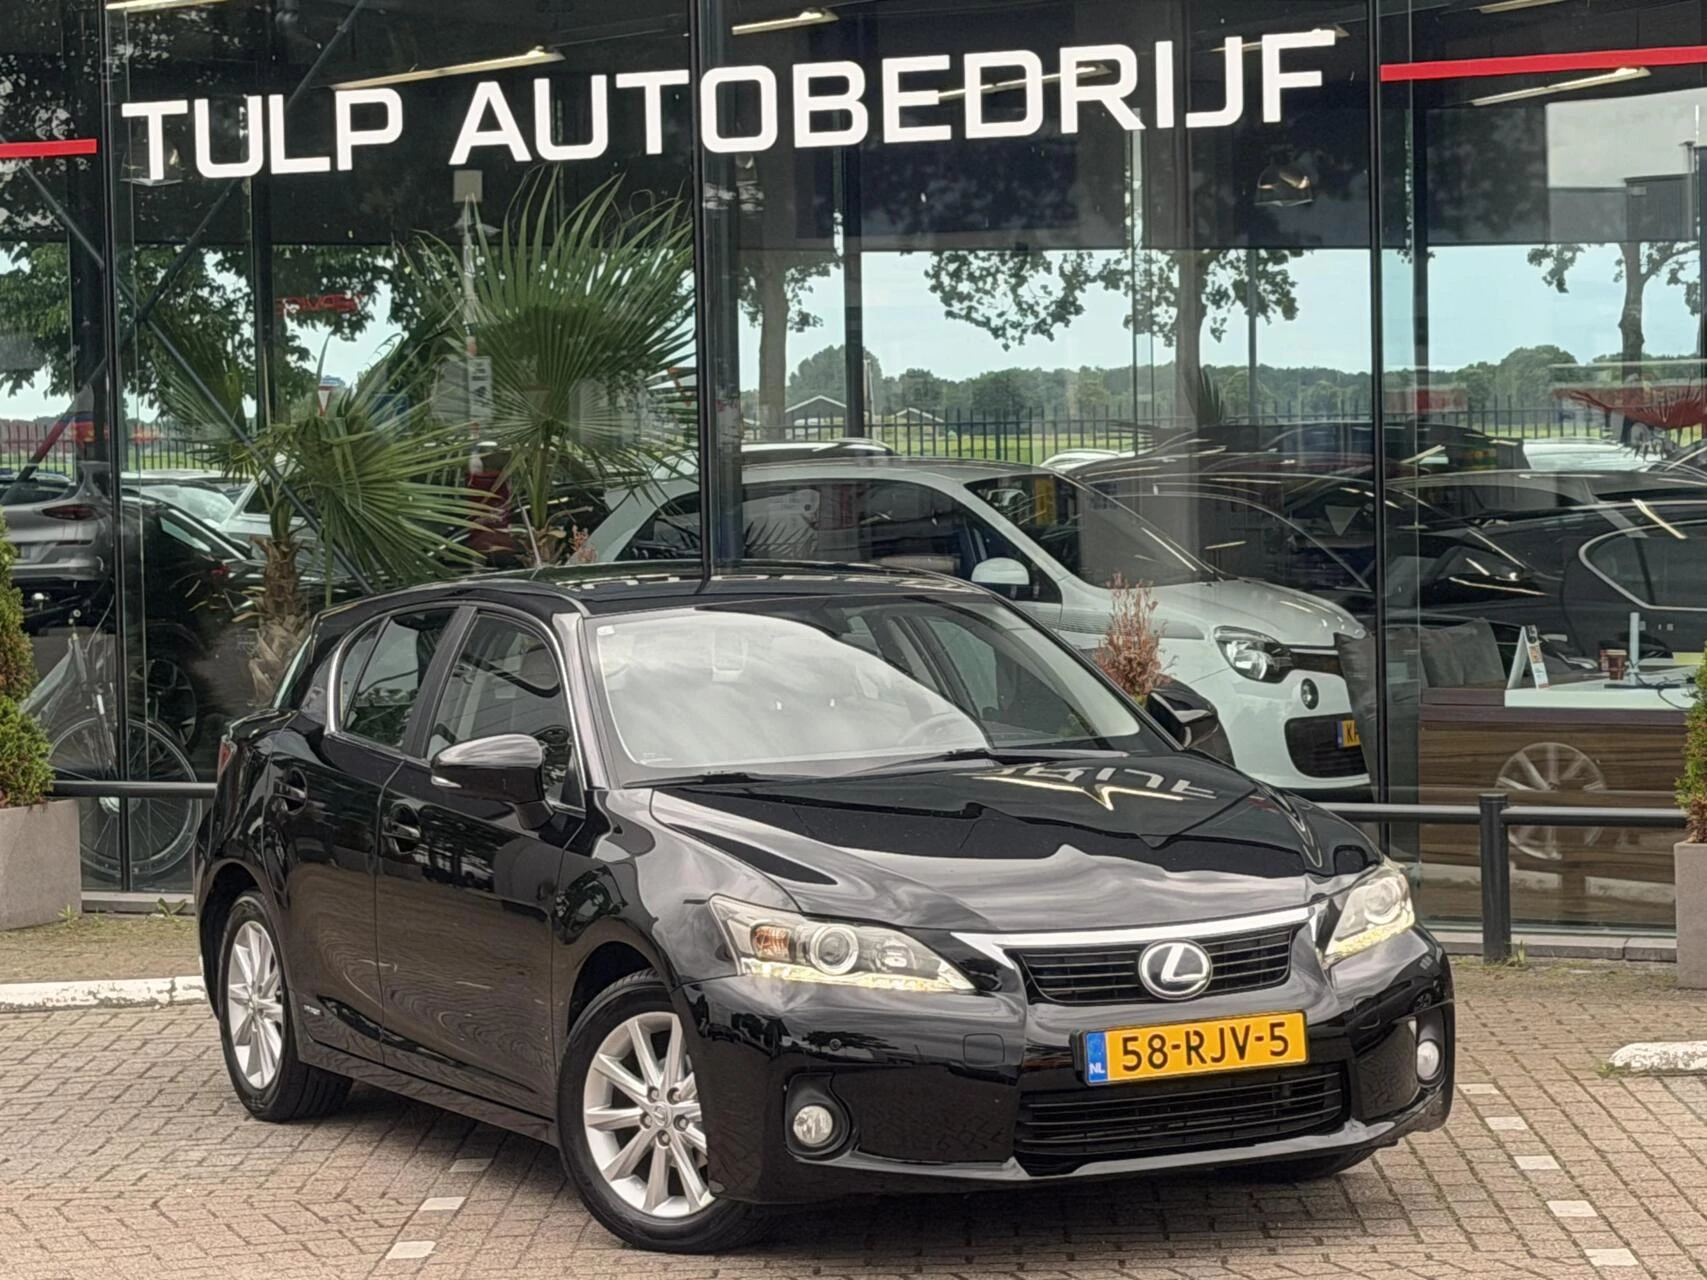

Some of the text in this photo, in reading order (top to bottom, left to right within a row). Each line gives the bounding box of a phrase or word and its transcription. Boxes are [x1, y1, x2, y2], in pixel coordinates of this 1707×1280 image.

[121, 28, 1336, 181] TULP AUTOBEDRIJF
[1088, 1062, 1106, 1074] NL
[1121, 1021, 1290, 1073] 58-RJV-5
